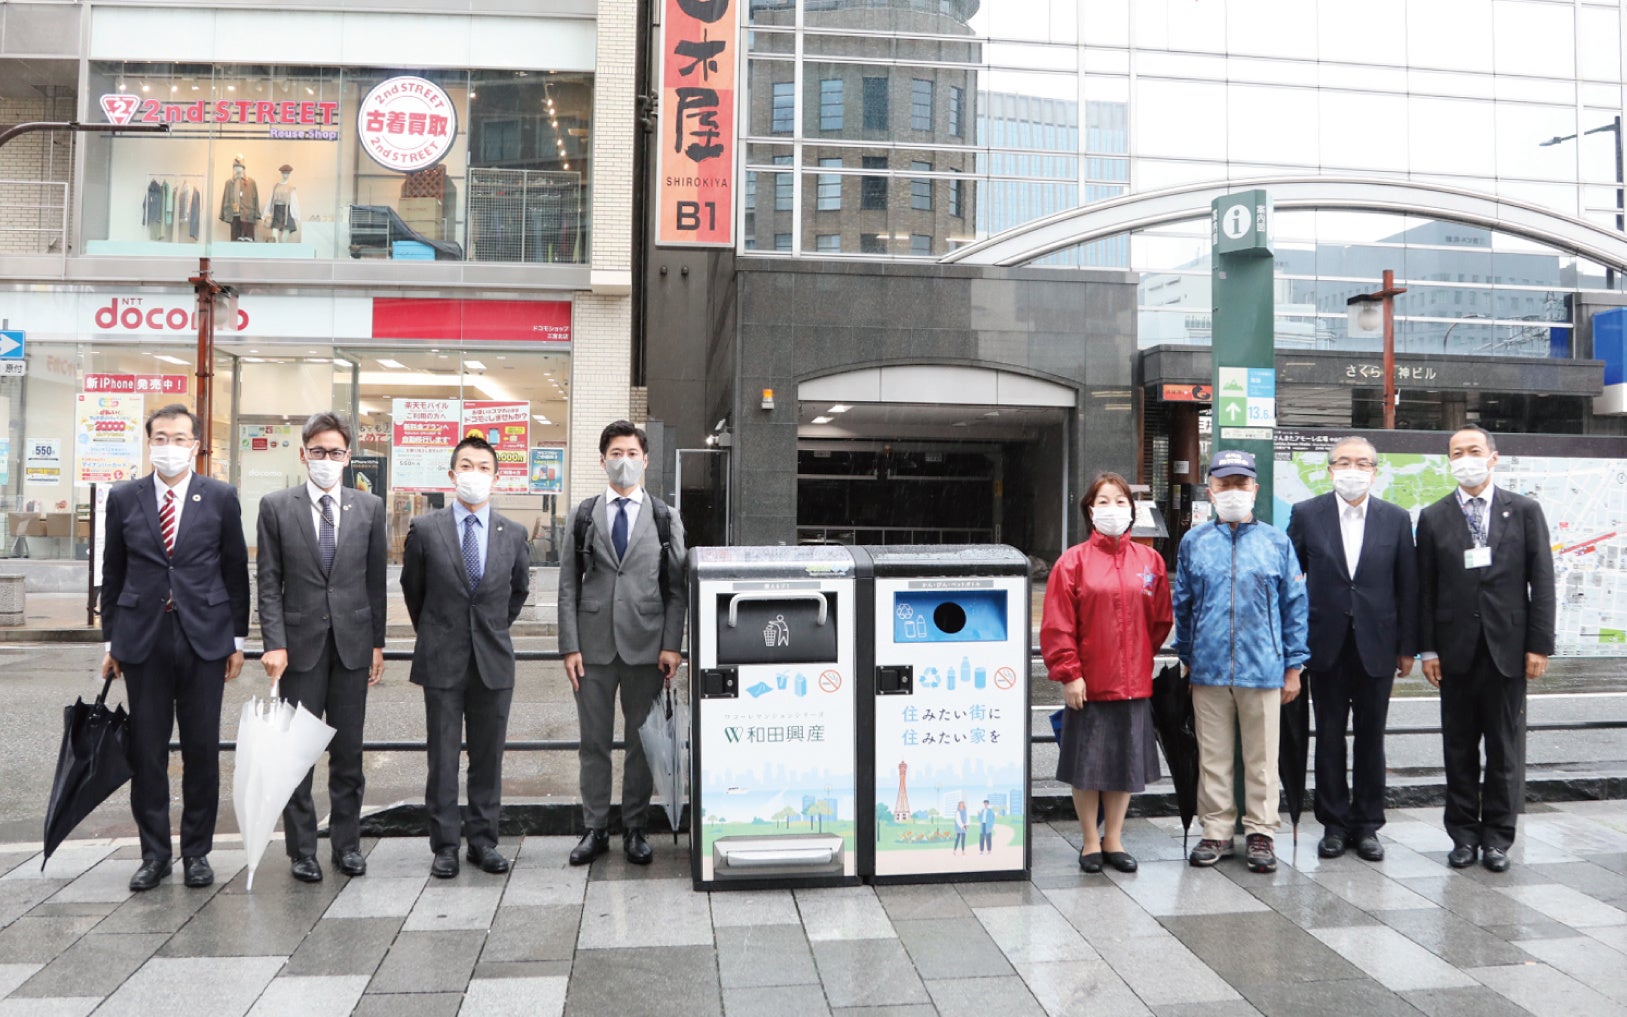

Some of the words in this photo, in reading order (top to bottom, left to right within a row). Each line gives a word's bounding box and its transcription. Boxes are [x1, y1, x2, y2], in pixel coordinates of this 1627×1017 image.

[375, 84, 399, 105] 2nd
[400, 82, 445, 109] STREET
[142, 99, 204, 123] 2nd
[215, 99, 339, 125] STREET
[366, 109, 449, 137] 古着買取
[270, 128, 305, 139] Reuse
[308, 129, 338, 141] Shop
[370, 136, 392, 158] 2nd
[392, 140, 439, 163] STREET
[666, 176, 728, 188] SHIROKIYA
[676, 201, 716, 231] B1
[121, 297, 143, 306] NTT
[5, 363, 23, 374] 原付
[1345, 364, 1438, 380] さくら神ビル
[902, 704, 1001, 723] 住みたい街に
[747, 724, 825, 744] 和田興産
[902, 728, 1001, 746] 住みたい家を
